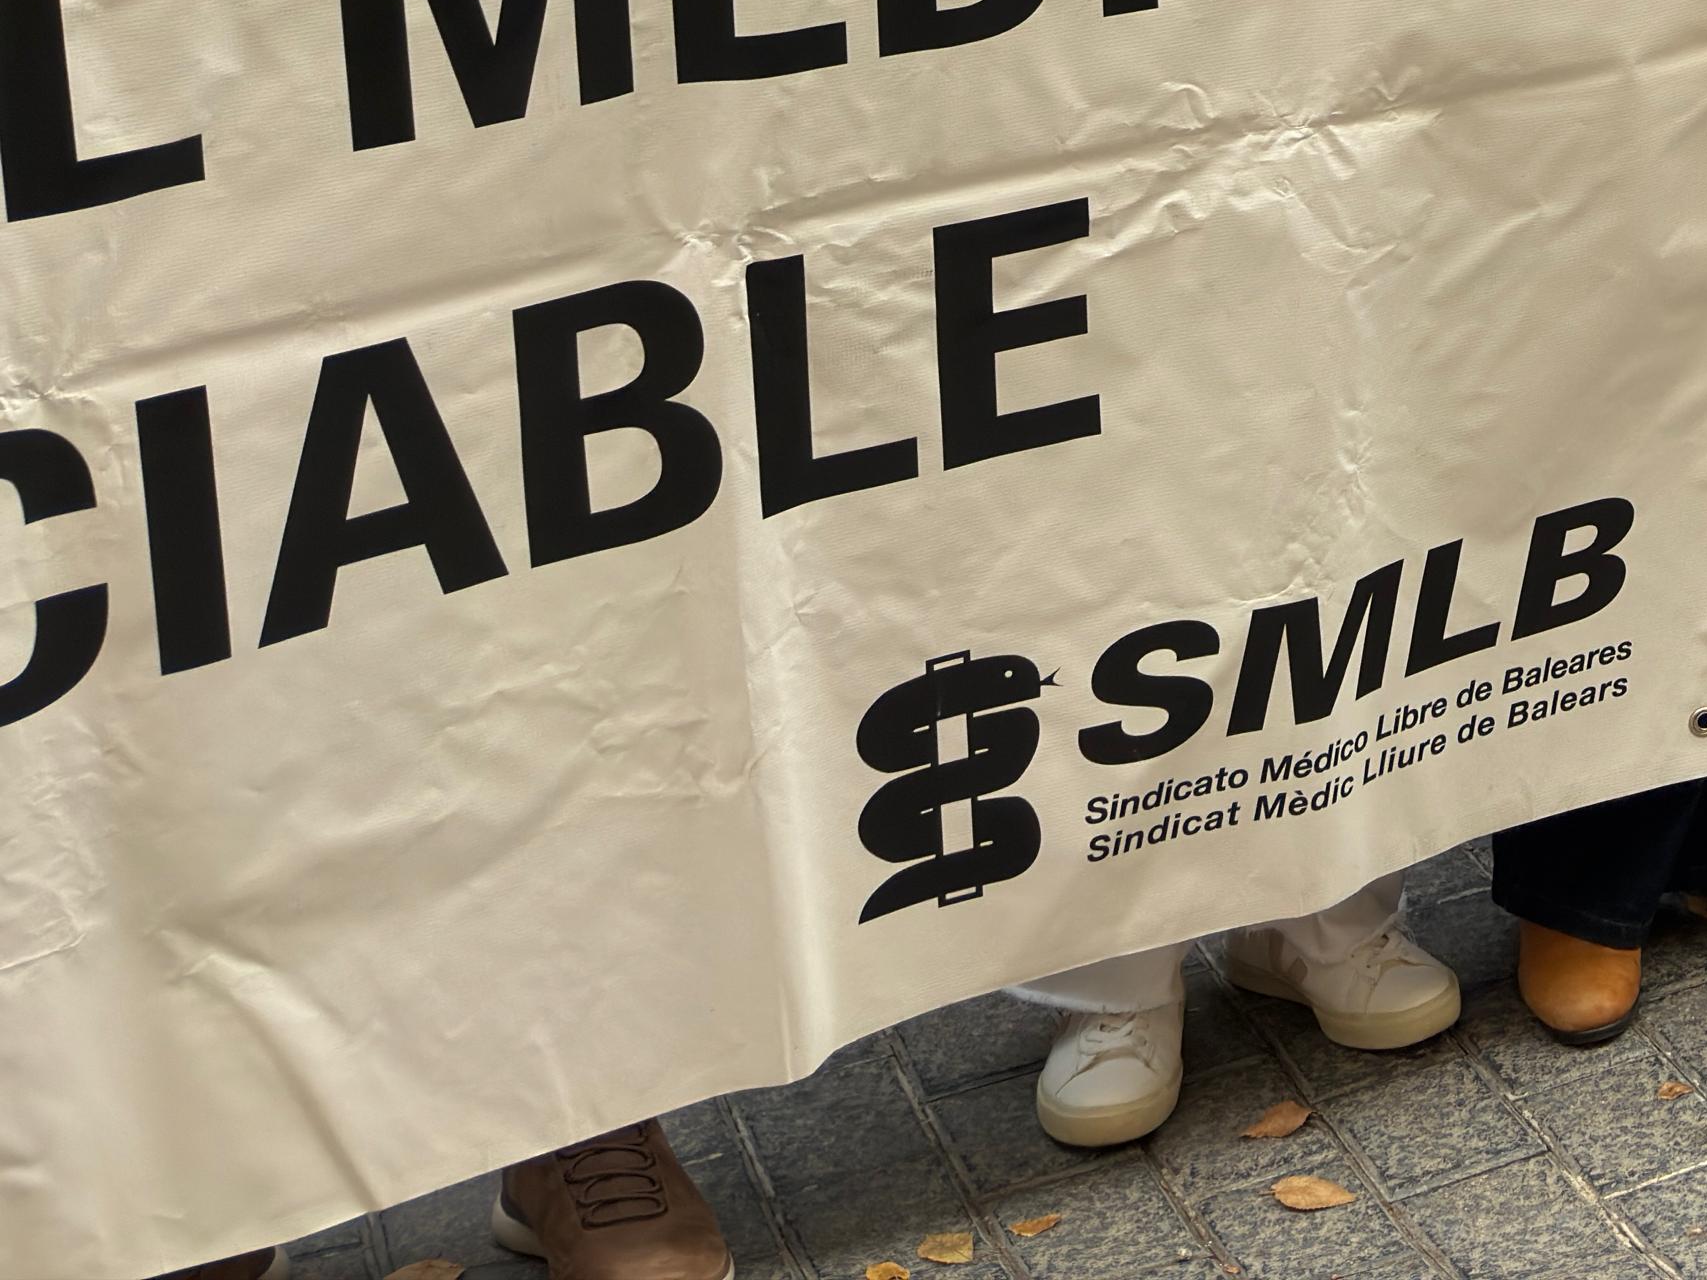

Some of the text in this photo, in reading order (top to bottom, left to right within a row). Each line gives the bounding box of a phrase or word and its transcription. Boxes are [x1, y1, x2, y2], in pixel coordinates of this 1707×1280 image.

[1077, 497, 1635, 765] SMLB
[1085, 640, 1633, 826] Sindicato Médico Libre de Baleares
[1087, 673, 1629, 863] Sindicat Mèdic Lliure de Balears
